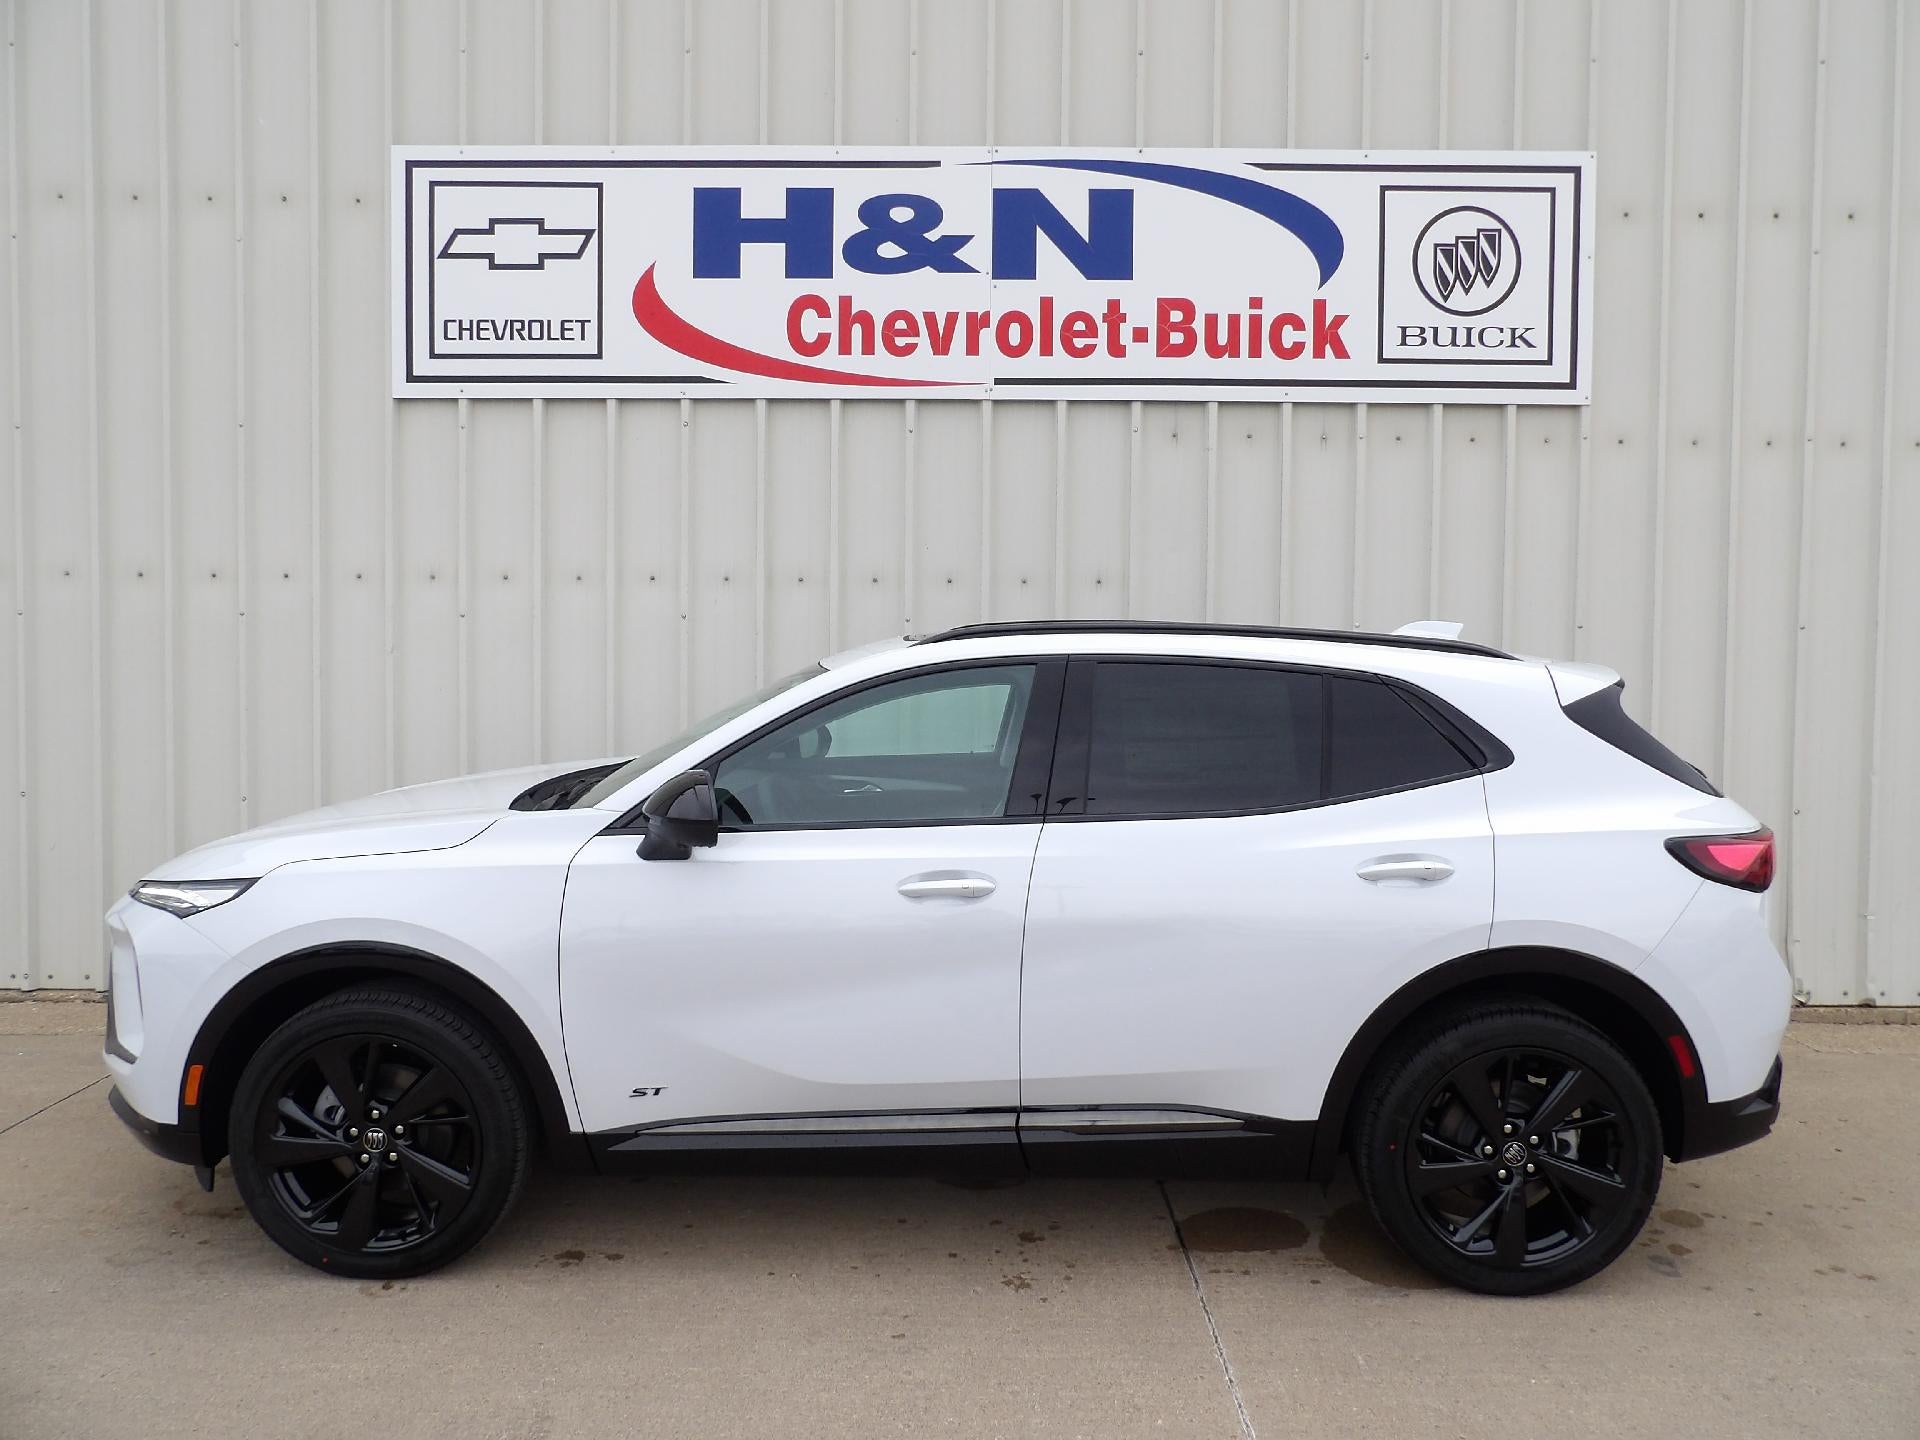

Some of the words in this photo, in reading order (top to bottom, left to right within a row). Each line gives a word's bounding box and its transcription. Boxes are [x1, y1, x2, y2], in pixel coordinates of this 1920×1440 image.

[693, 187, 1134, 280] H&N
[442, 318, 592, 342] CHEVROLET
[786, 293, 1351, 360] Chevrolet-Buick
[1396, 325, 1537, 349] BUICK
[628, 1086, 669, 1098] ST
